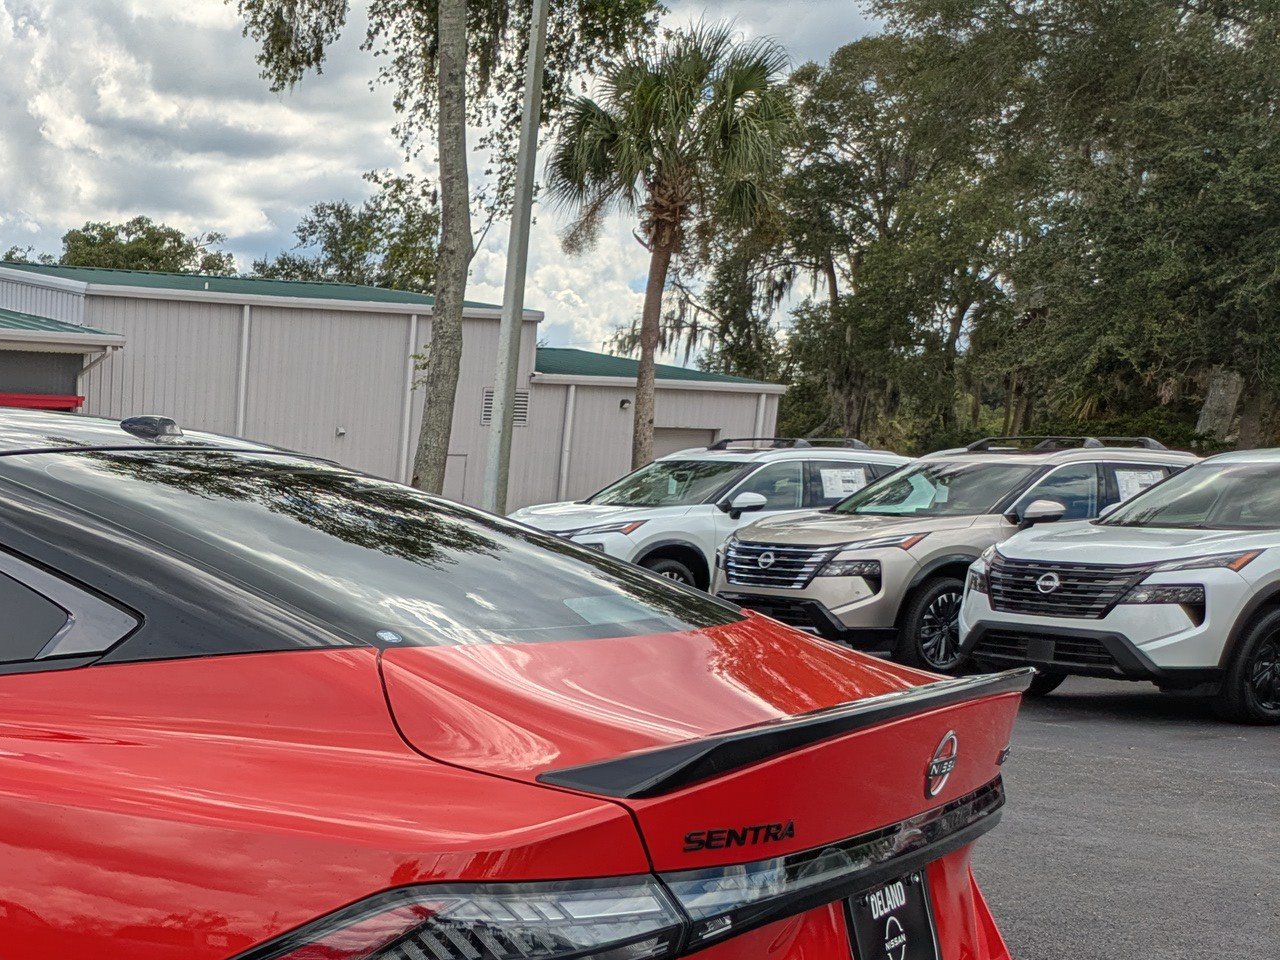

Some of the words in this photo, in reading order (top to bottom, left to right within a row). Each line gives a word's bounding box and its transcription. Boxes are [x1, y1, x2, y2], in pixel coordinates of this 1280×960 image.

[683, 820, 795, 852] SENTRA
[870, 881, 906, 919] DELAND
[885, 933, 906, 951] NISSAN
